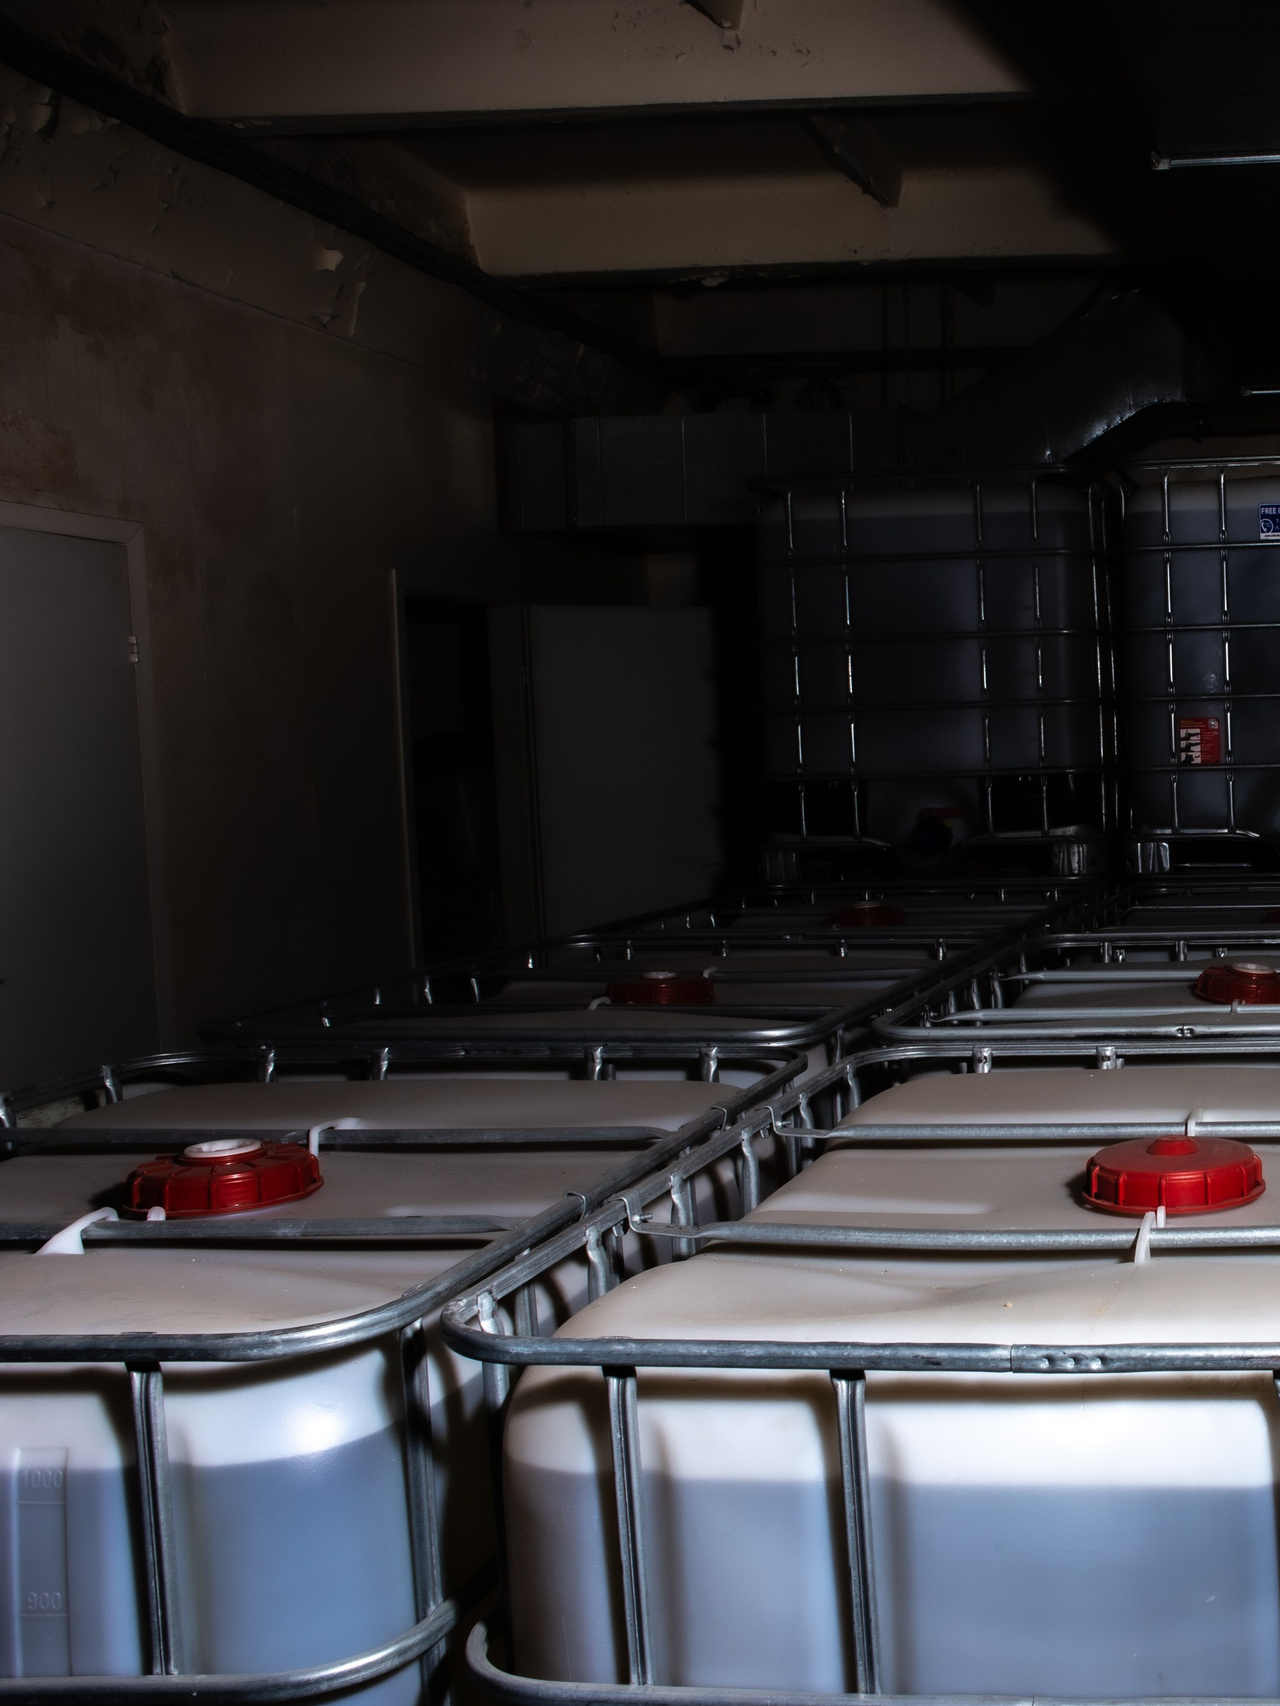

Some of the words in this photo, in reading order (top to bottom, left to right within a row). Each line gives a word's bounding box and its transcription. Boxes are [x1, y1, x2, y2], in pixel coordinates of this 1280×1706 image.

[1261, 507, 1277, 515] FREE
[22, 1470, 64, 1488] 1000
[27, 1591, 62, 1610] 900
